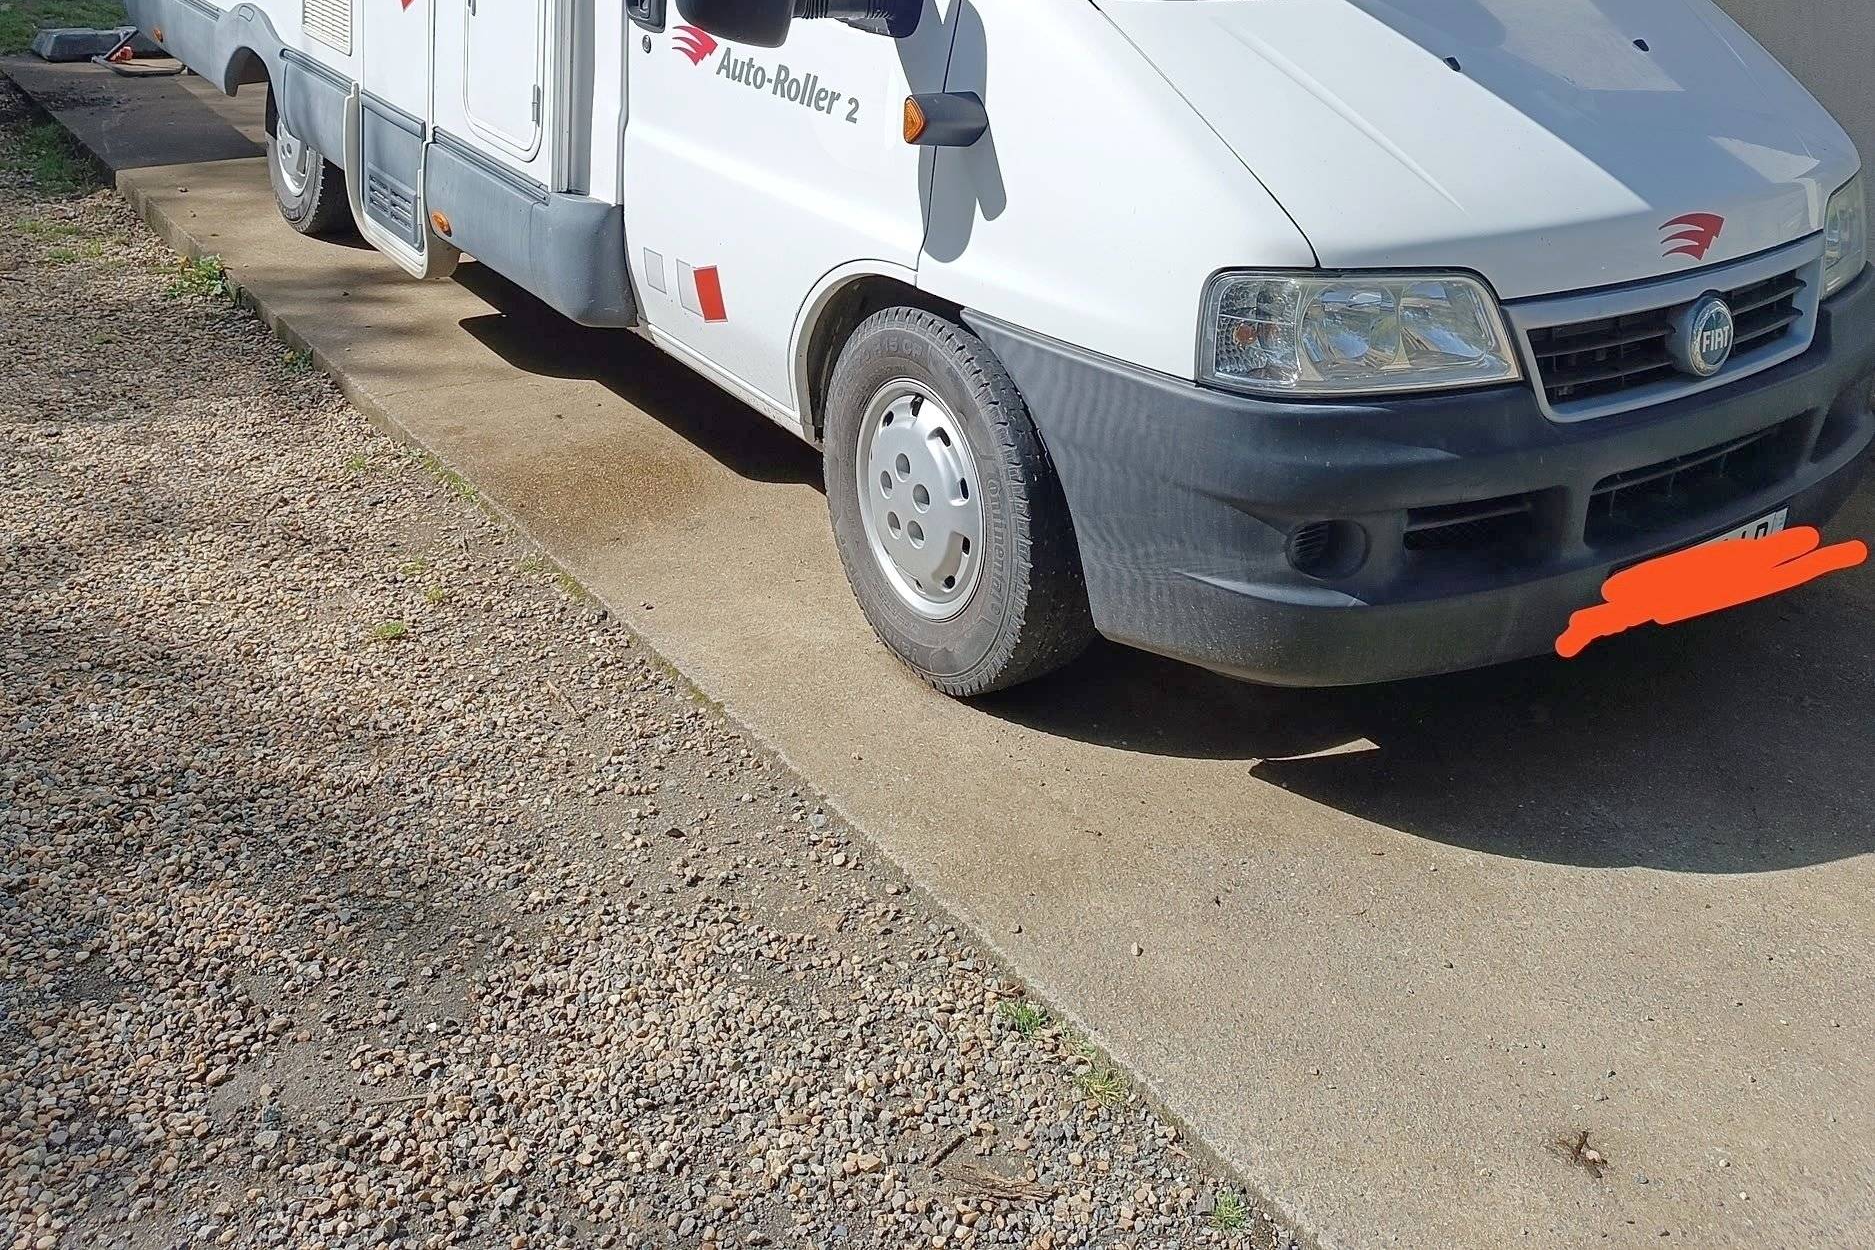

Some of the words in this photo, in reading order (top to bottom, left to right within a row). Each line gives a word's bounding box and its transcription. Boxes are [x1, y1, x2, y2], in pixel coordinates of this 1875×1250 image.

[716, 47, 841, 115] Auto-Roller
[845, 97, 860, 124] 2
[1702, 326, 1730, 353] FIAT
